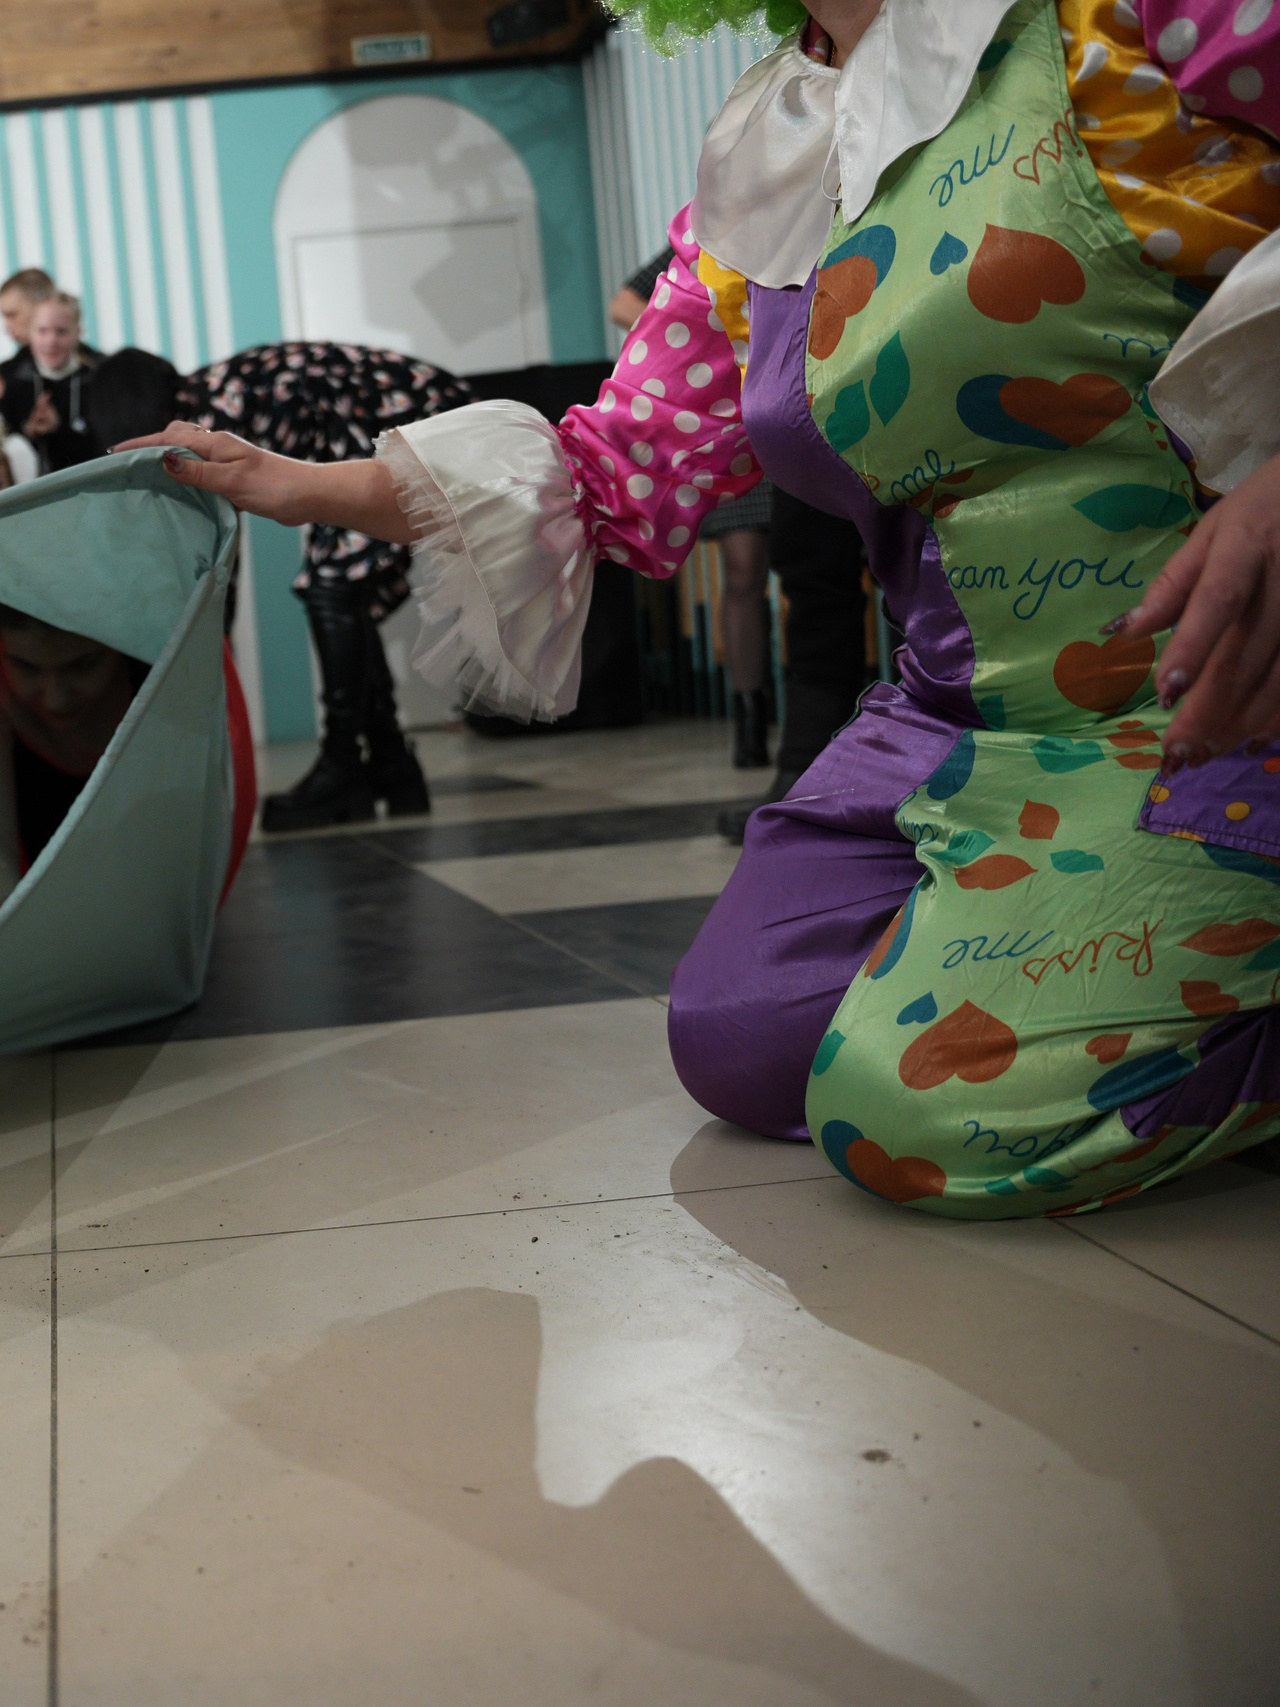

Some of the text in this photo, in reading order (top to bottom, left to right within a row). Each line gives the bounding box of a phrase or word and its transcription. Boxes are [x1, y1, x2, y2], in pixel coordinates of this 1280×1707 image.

[929, 108, 1084, 208] iss me
[948, 557, 1144, 621] can you
[942, 929, 1055, 970] me
